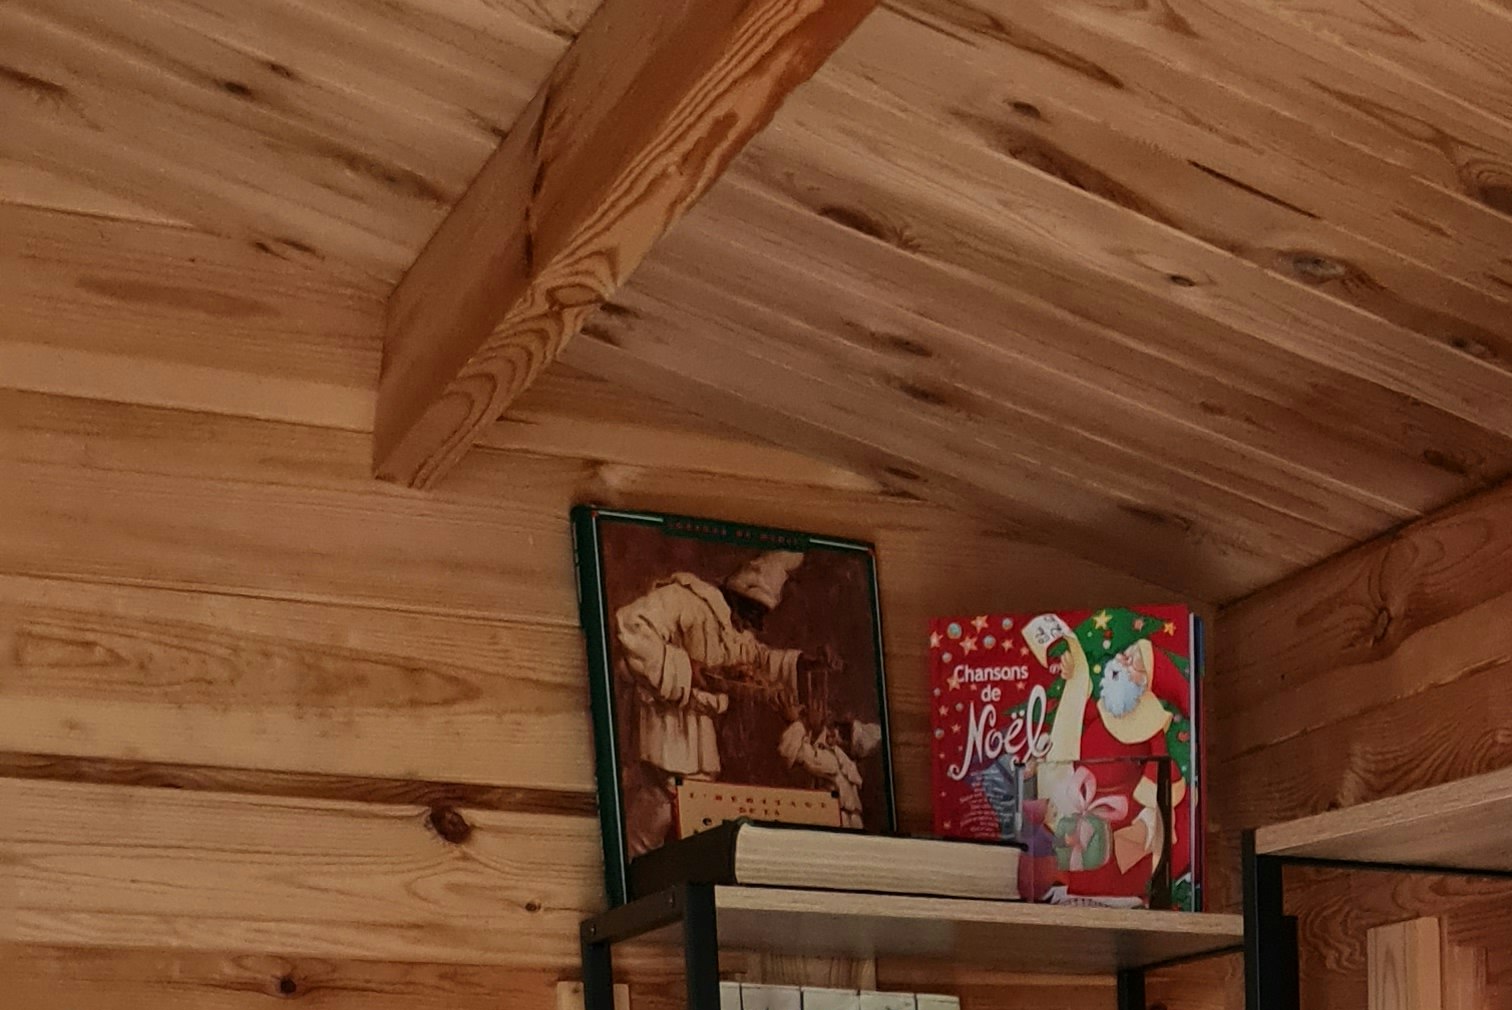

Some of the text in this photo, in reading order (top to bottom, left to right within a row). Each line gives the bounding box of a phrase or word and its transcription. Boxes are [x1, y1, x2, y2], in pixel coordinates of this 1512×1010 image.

[954, 664, 1029, 683] Chansons
[981, 684, 1001, 701] de
[949, 684, 1053, 780] Noël
